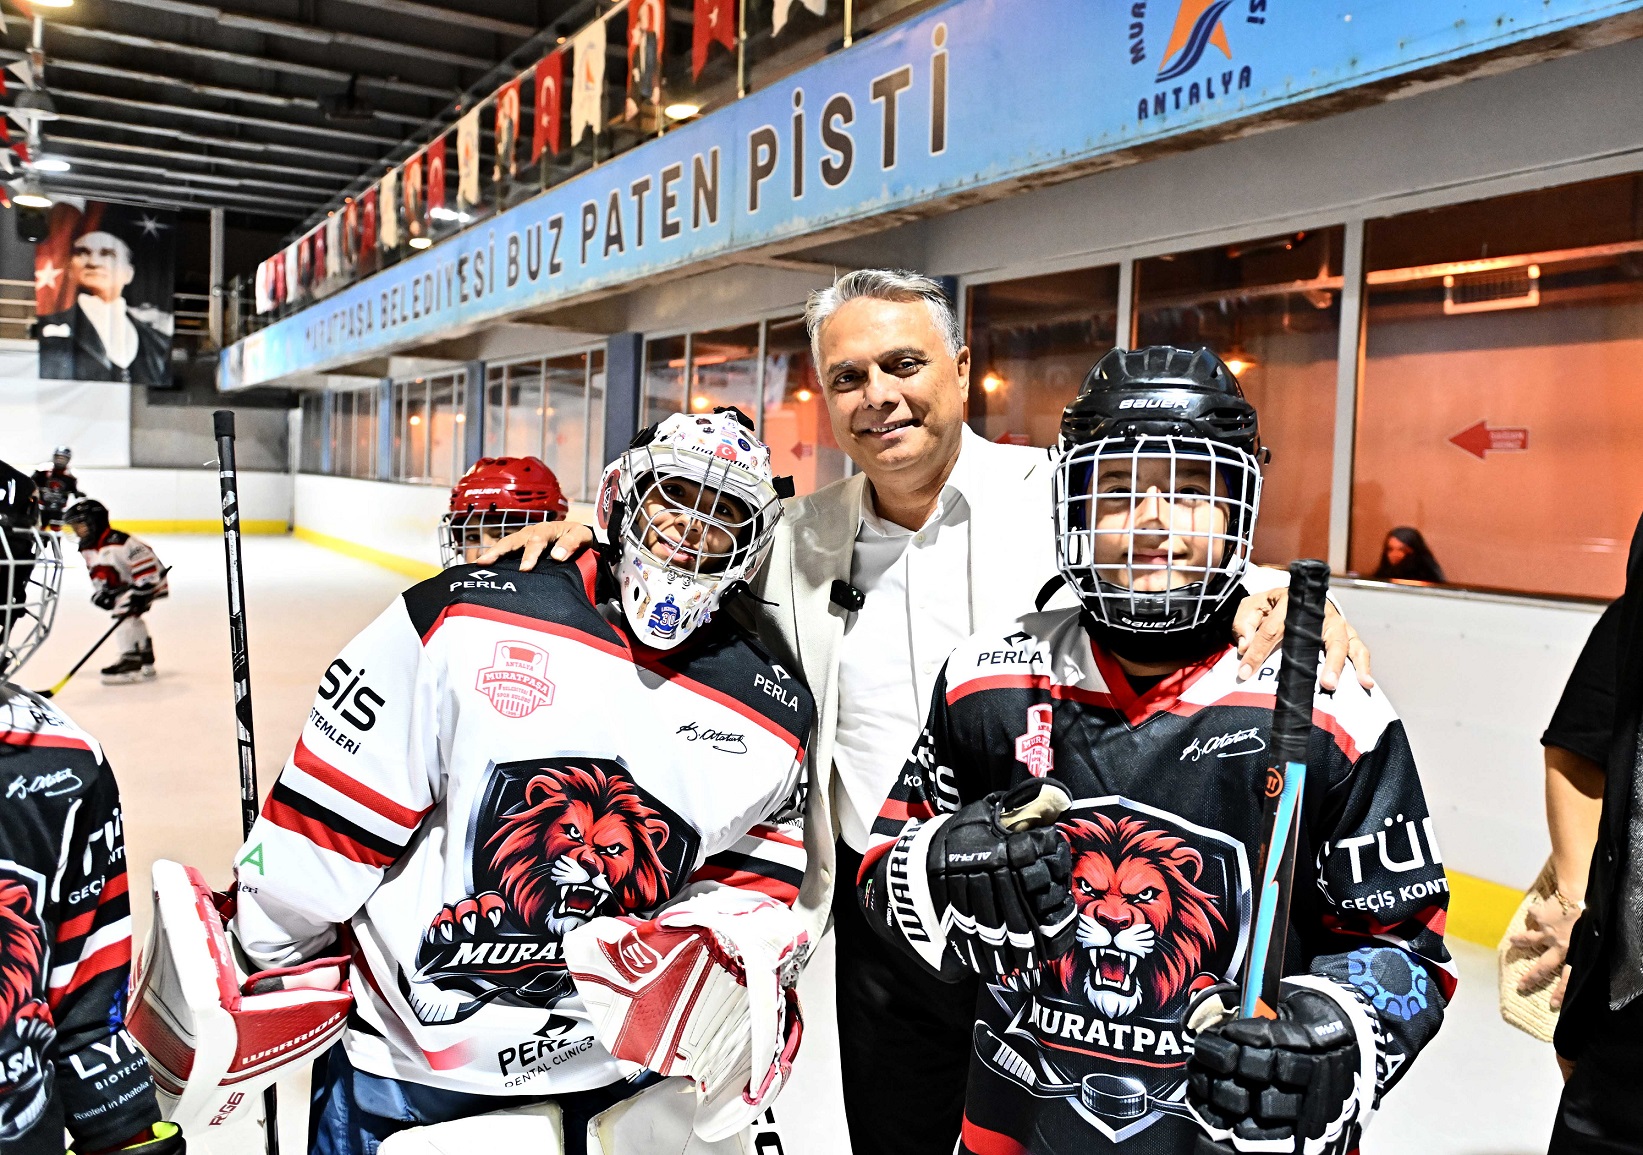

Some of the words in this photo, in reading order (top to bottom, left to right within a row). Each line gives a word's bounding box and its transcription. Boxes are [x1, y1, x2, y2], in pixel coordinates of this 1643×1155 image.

[1137, 65, 1252, 120] ANTALYA
[381, 229, 496, 330] BELEDİYESİ
[506, 213, 563, 289] BUZ
[580, 147, 720, 265] PATEN
[748, 22, 949, 214] PİSTİ
[1118, 398, 1190, 410] BAUER
[449, 580, 517, 593] PERLA
[505, 661, 534, 672] ANTALYA
[976, 650, 1044, 667] PERLA
[753, 673, 799, 712] PERLA
[1341, 889, 1396, 913] GEÇİŞ
[241, 1011, 342, 1066] WARRIOR
[504, 1063, 552, 1088] DENTAL
[552, 1040, 595, 1066] CLINICS
[73, 1103, 108, 1121] Rooted
[108, 1099, 119, 1110] in
[118, 1080, 150, 1105] Anatolia
